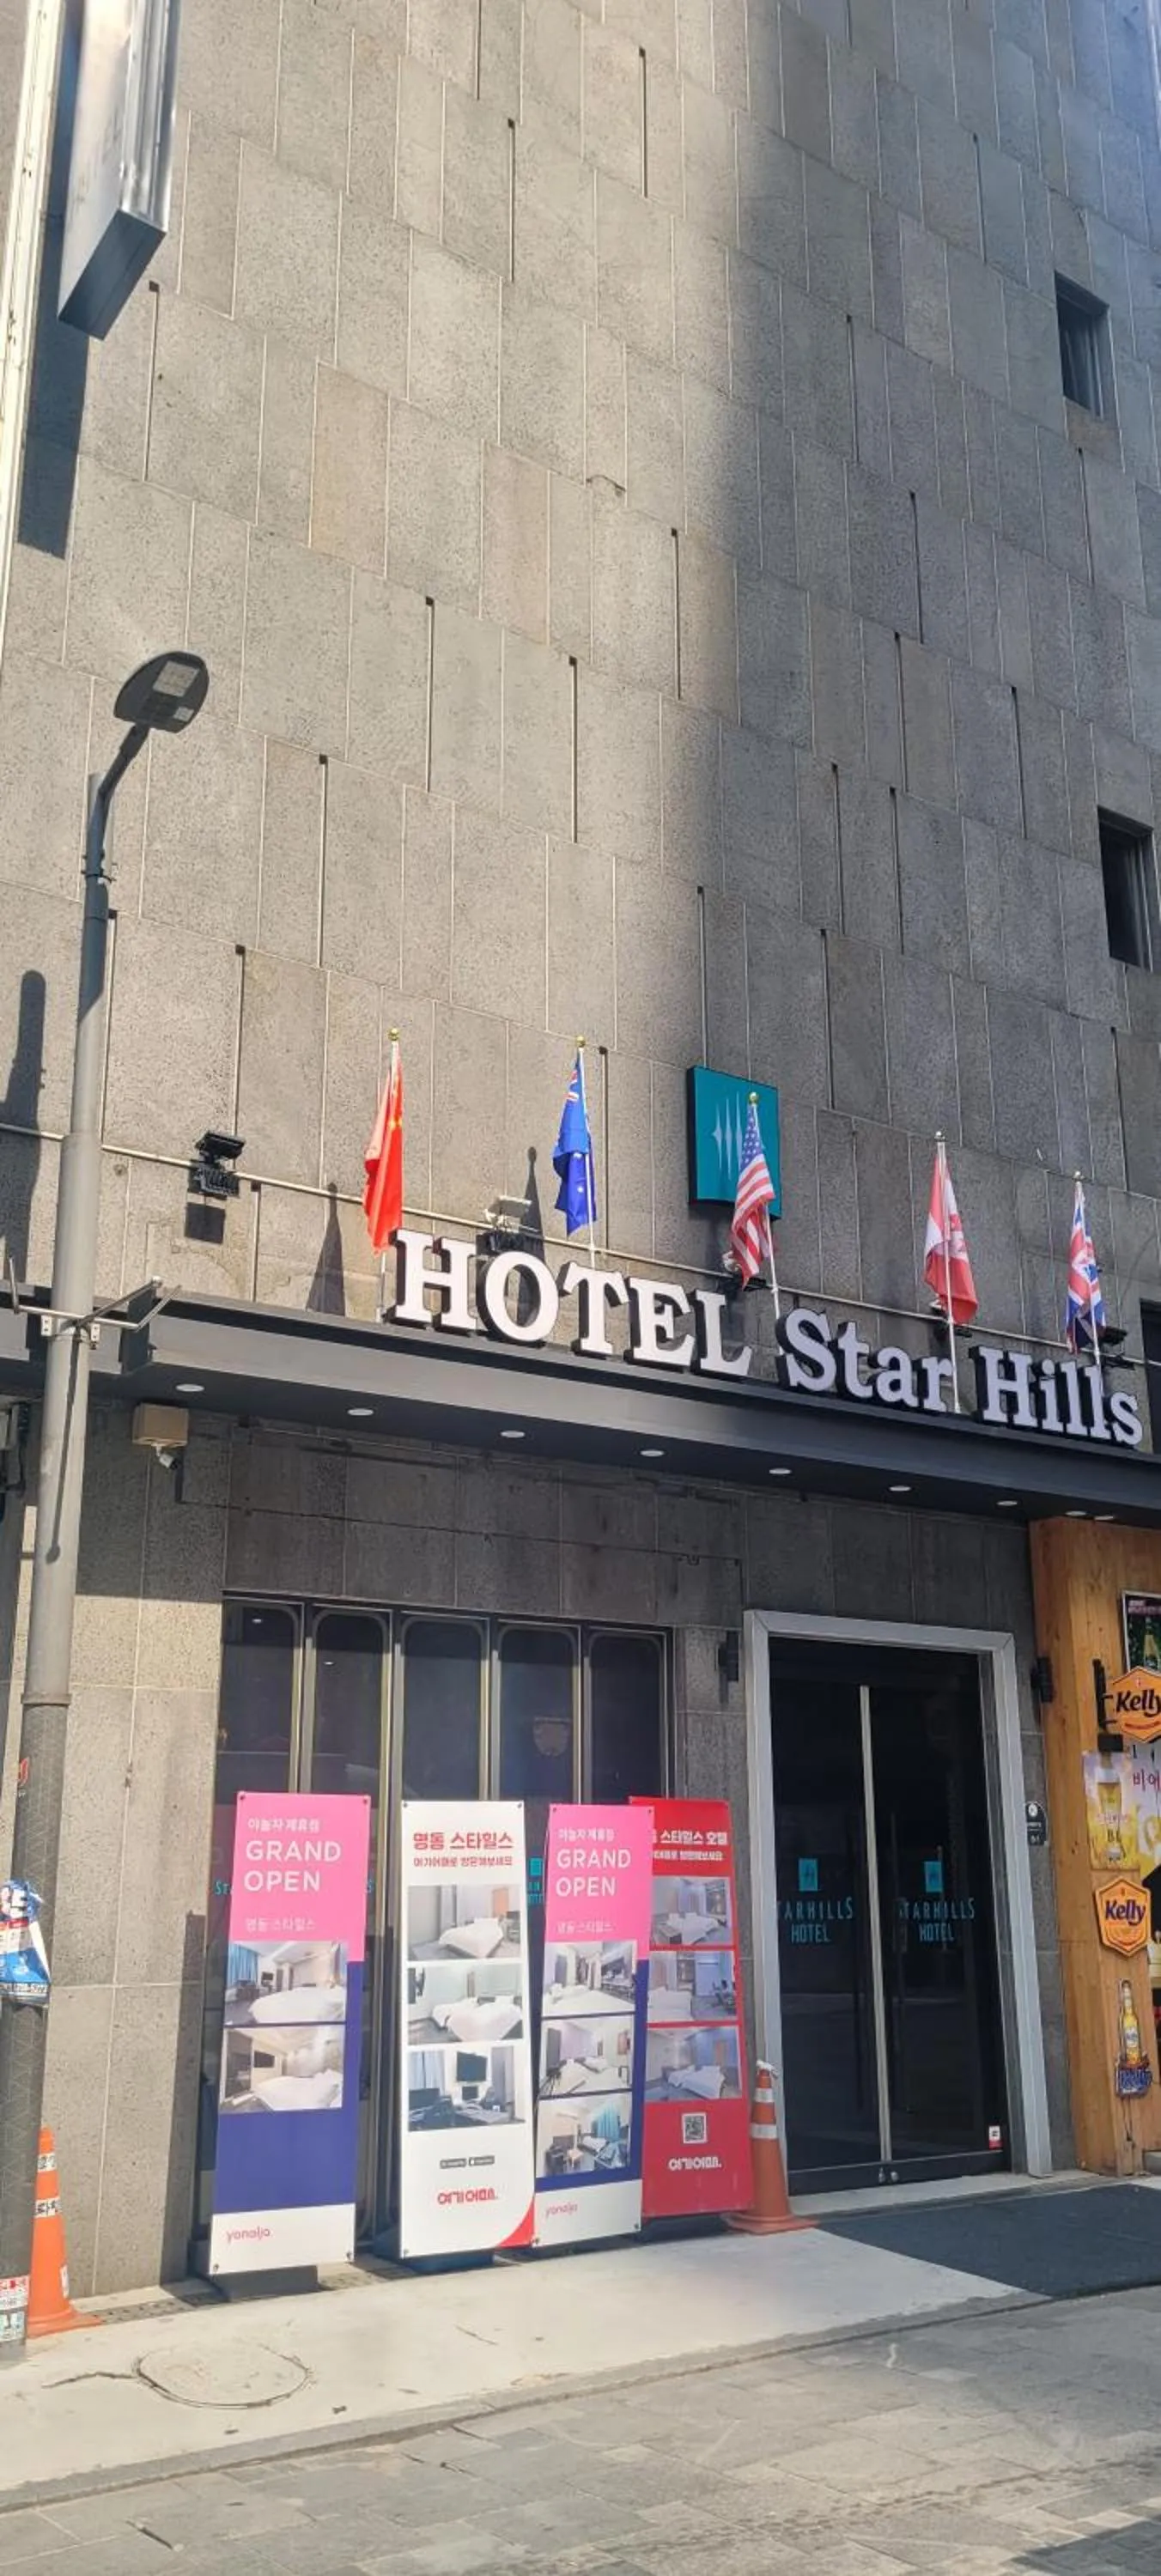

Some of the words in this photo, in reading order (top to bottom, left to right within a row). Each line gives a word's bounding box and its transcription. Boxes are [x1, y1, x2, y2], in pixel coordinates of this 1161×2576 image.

[393, 1228, 753, 1376] HOTEL
[780, 1307, 953, 1413] Star
[976, 1345, 1144, 1446] Hills
[1115, 1688, 1160, 1717] Kelly
[412, 1832, 446, 1851] 명동
[449, 1831, 514, 1850] 스타힐스
[660, 1830, 703, 1845] 스타힐스
[246, 1839, 342, 1862] GRAND
[556, 1848, 632, 1869] GRAND
[243, 1869, 321, 1893] OPEN
[556, 1876, 617, 1898] OPEN
[776, 1896, 854, 1921] TARHILLS
[1105, 1899, 1146, 1926] Kelly
[790, 1923, 832, 1944] HOTEL
[919, 1919, 955, 1942] HOTEL
